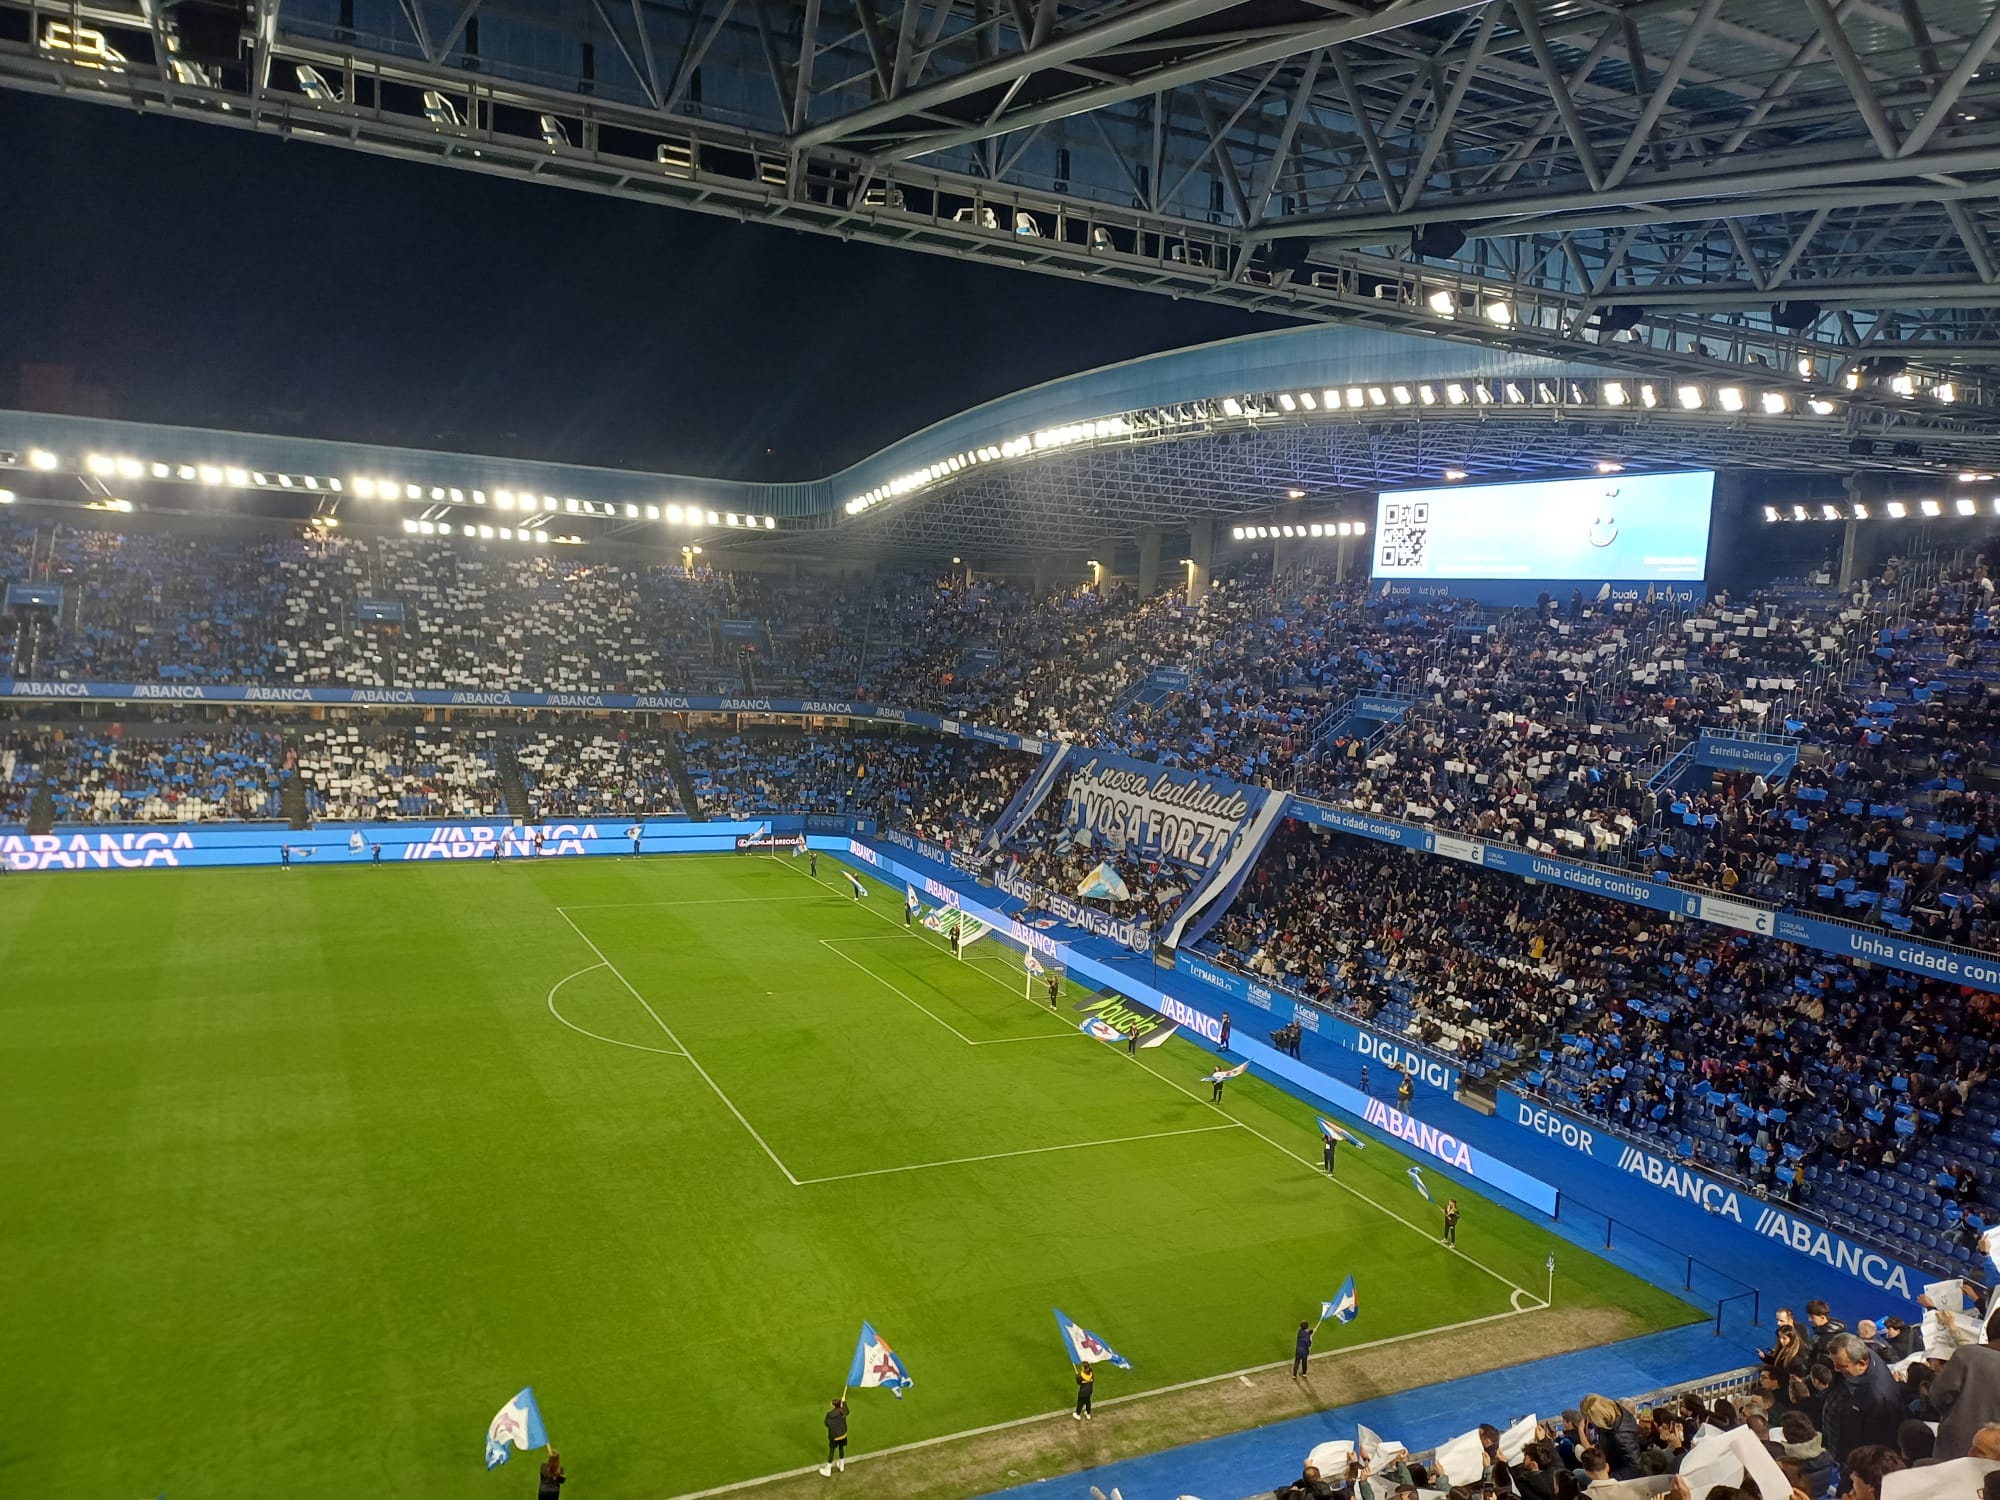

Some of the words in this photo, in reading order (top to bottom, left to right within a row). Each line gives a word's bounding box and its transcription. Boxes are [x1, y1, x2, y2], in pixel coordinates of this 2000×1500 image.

[1709, 745, 1740, 757] Estrella
[1742, 748, 1771, 761] Galicia
[1074, 758, 1098, 782] A
[1098, 767, 1148, 796] nosa
[1151, 773, 1248, 820] lealdade
[1321, 810, 1341, 825] Unha
[1342, 815, 1369, 831] cidade
[1370, 822, 1401, 840] contigo
[1532, 860, 1561, 880] Unha
[1563, 867, 1602, 888] cidade
[1604, 878, 1650, 900] contigo
[1850, 934, 1894, 960] Unha
[1899, 946, 1959, 975] cidade
[1964, 963, 2000, 985] con
[1405, 1051, 1449, 1091] DIGI
